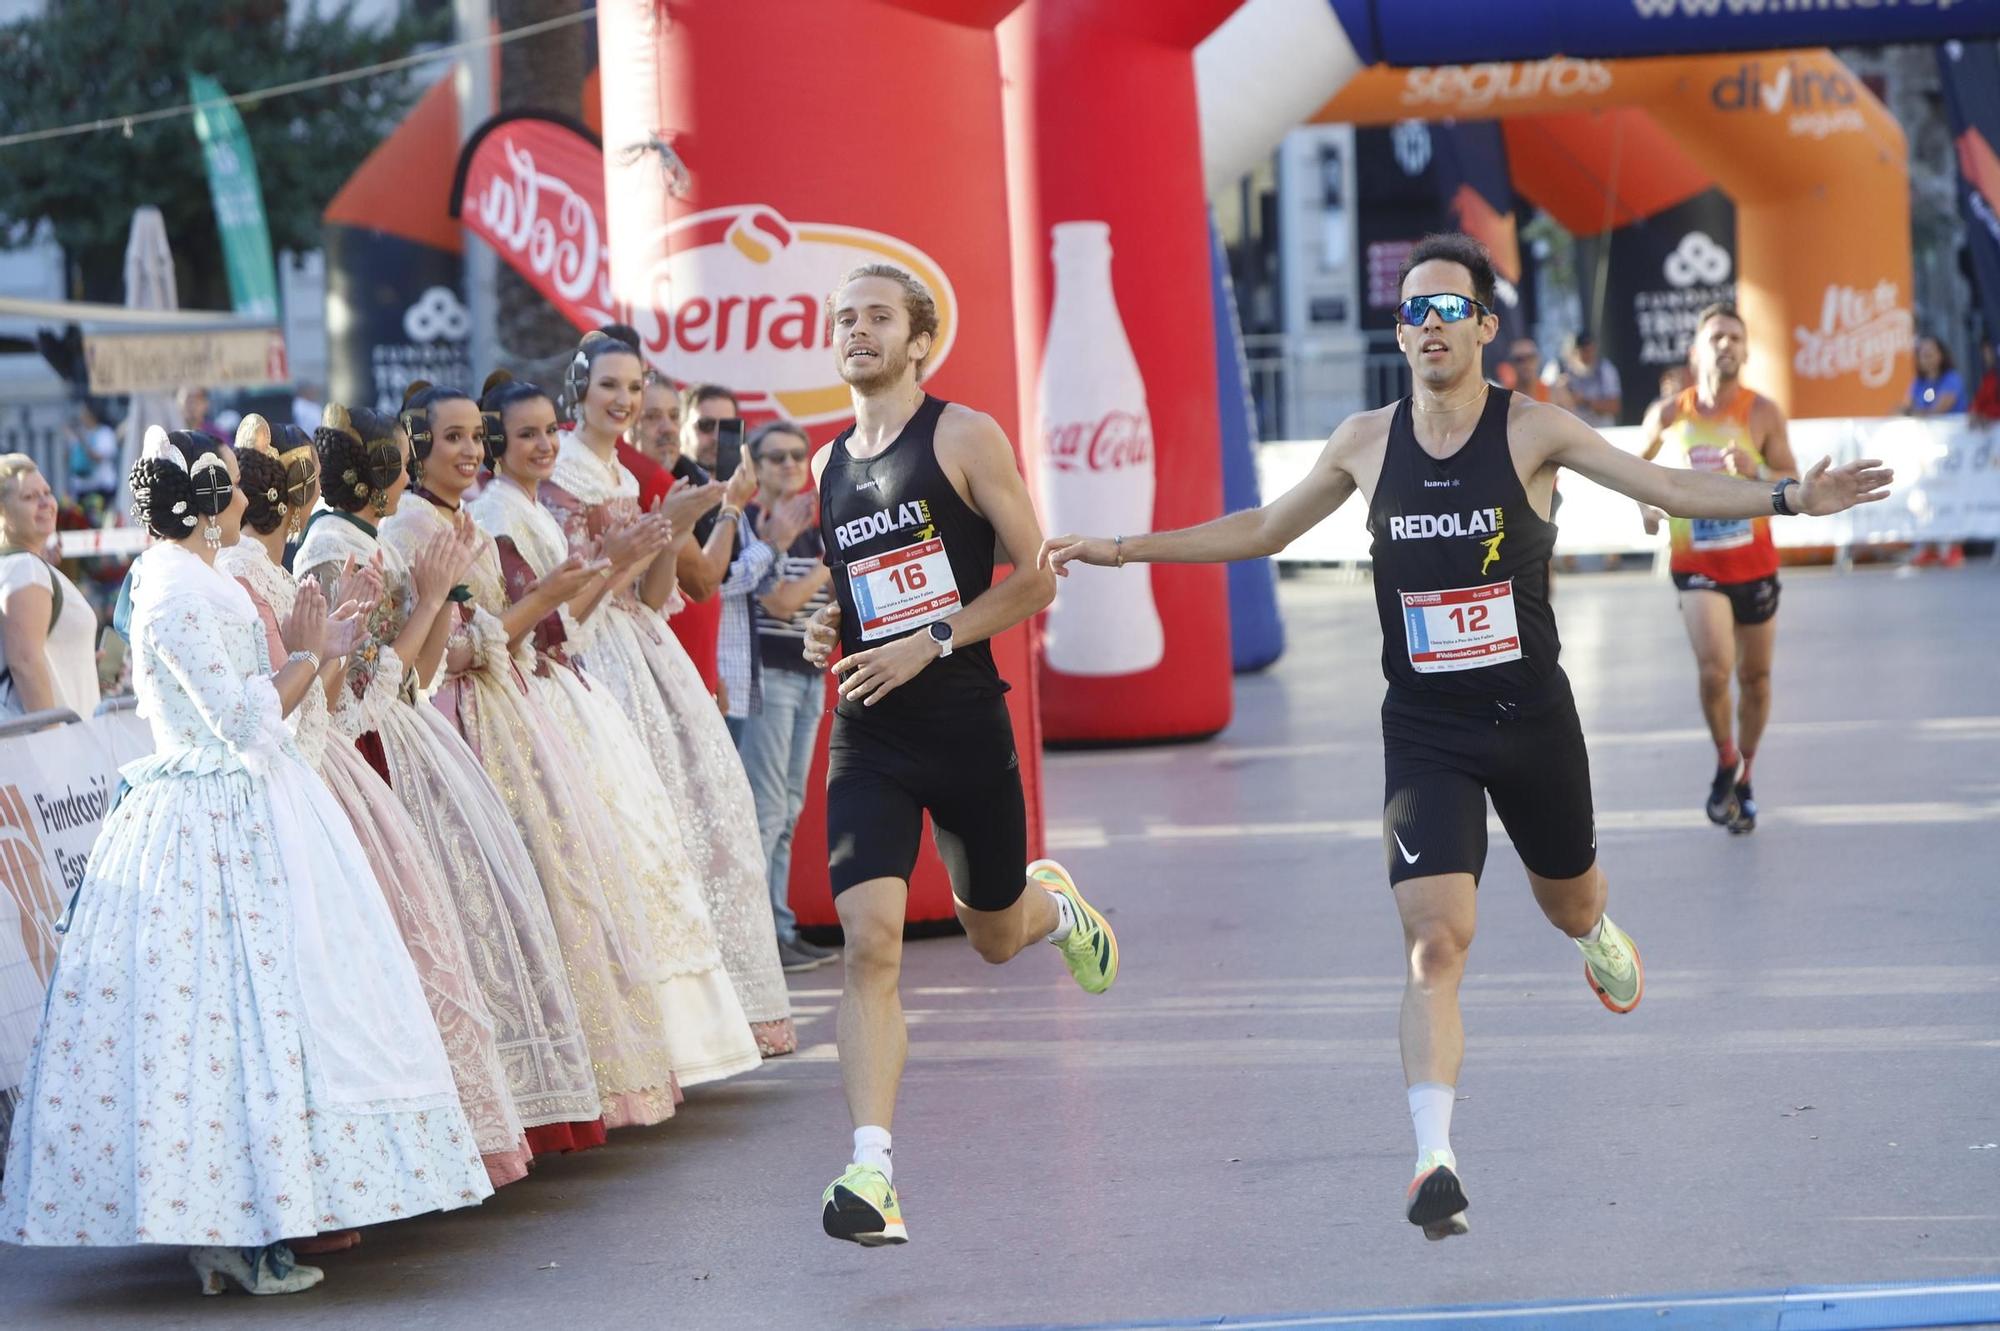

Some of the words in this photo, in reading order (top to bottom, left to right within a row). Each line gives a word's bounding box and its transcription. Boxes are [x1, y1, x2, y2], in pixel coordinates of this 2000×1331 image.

[643, 273, 834, 353] Serra
[835, 501, 926, 550] REDOLAT
[919, 500, 932, 522] TEAM
[1390, 508, 1497, 540] REDOLAT
[1494, 507, 1504, 530] TEAM
[889, 563, 928, 594] 16
[1449, 605, 1491, 633] 12
[34, 775, 109, 834] Fundació
[54, 848, 91, 889] Esp
